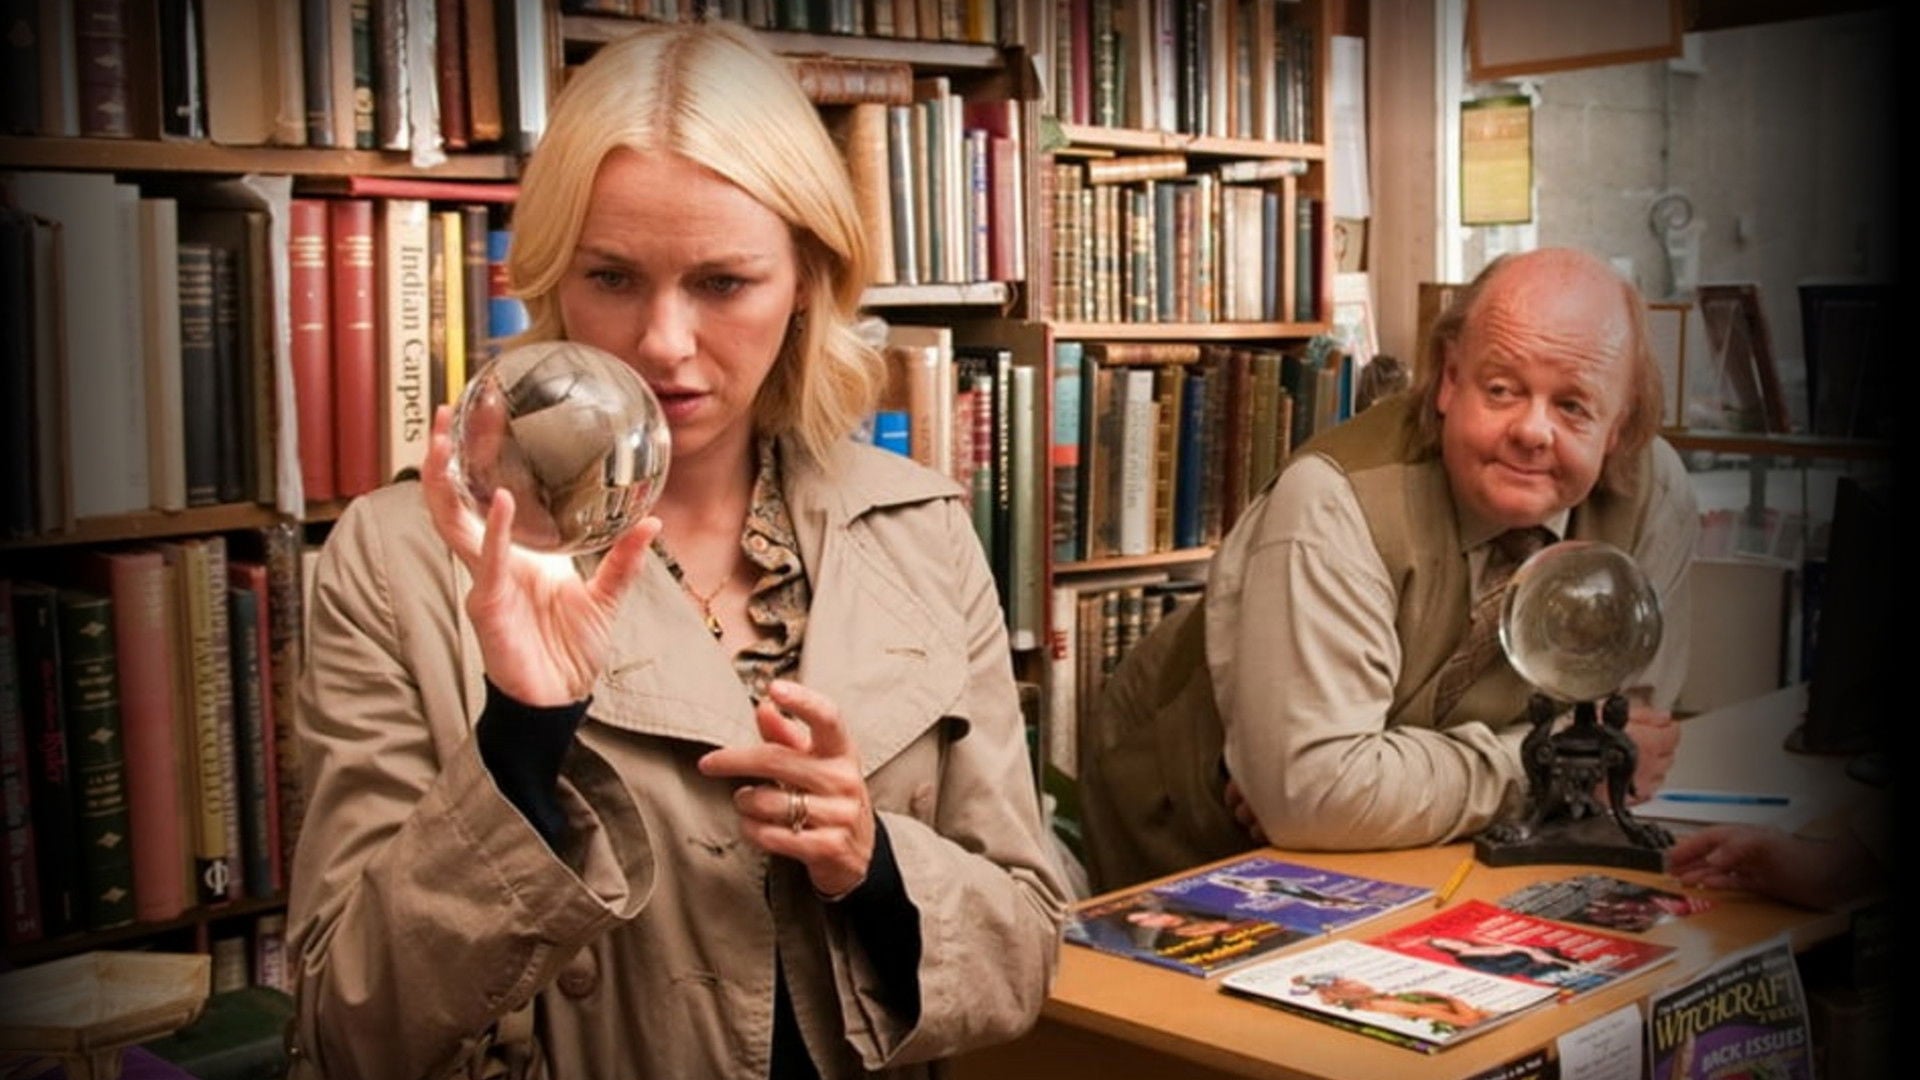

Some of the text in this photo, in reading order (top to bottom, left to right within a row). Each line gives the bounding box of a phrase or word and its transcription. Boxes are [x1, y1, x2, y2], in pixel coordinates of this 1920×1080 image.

[396, 245, 425, 443] Indian Carpets
[1655, 971, 1797, 1051] WITCHCRAFT
[1745, 1027, 1805, 1052] ISSUES
